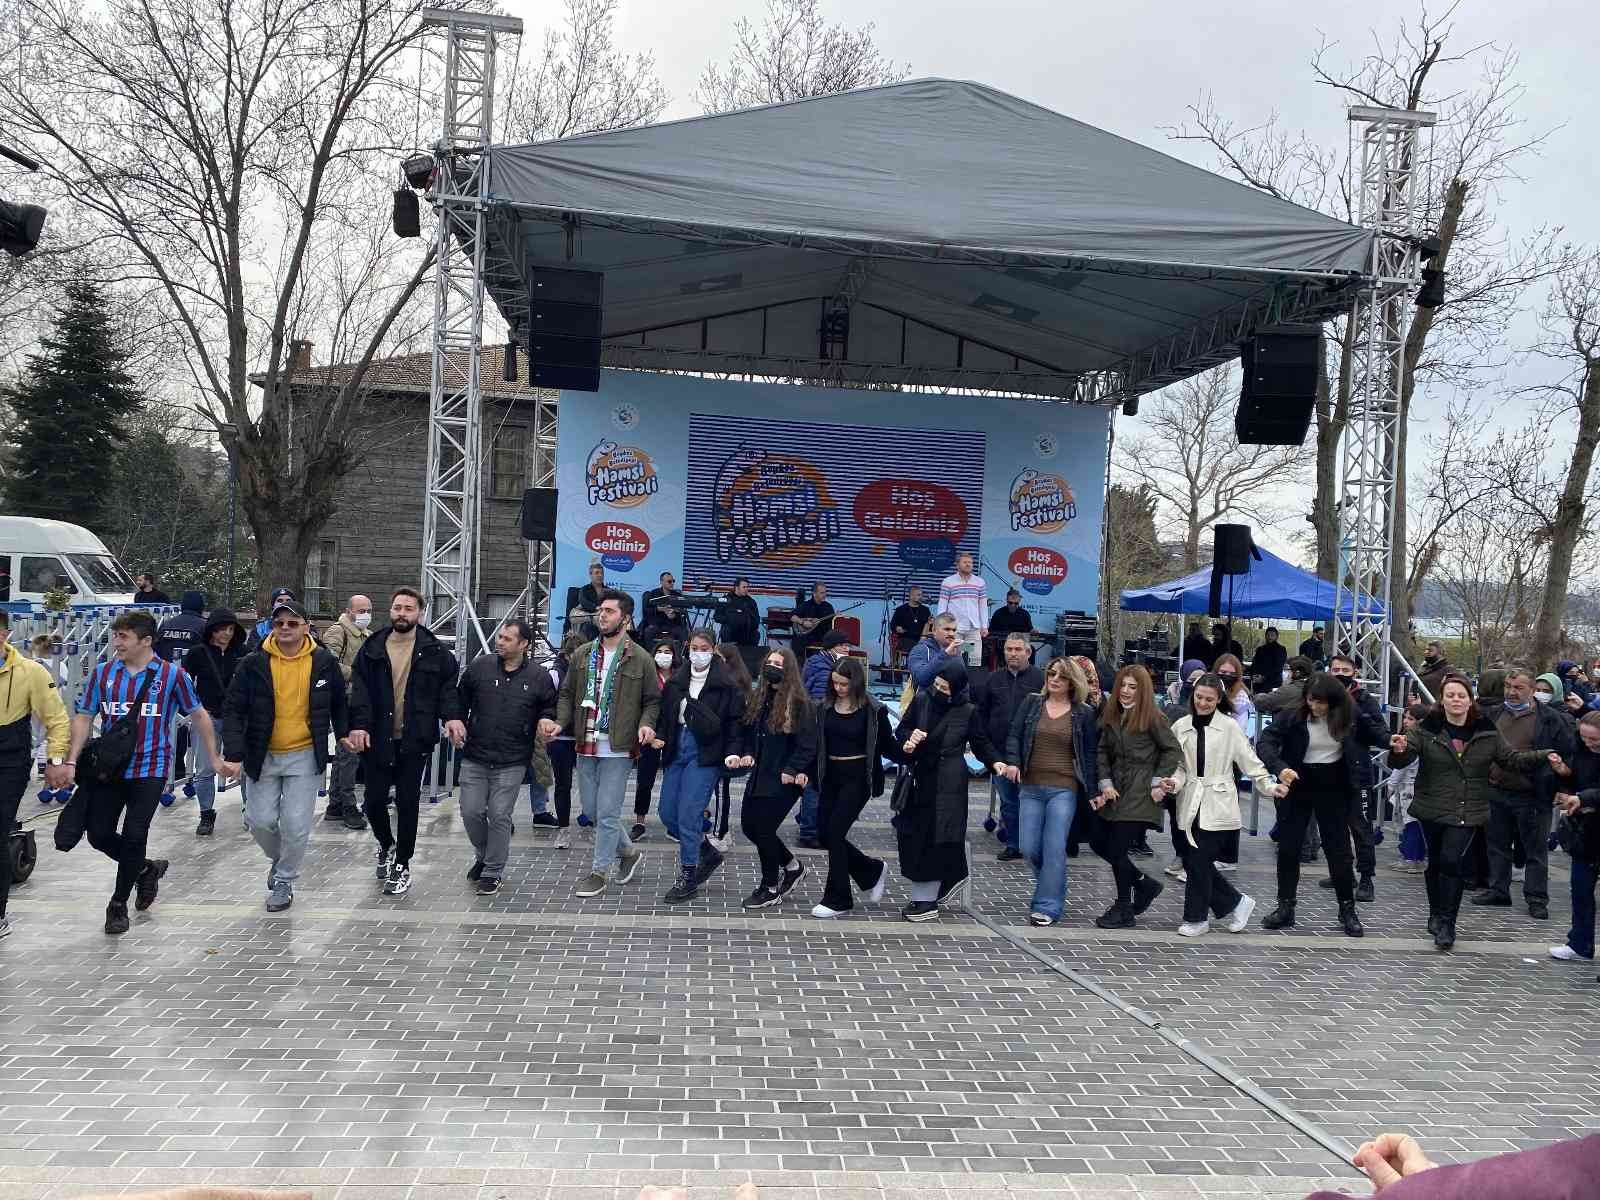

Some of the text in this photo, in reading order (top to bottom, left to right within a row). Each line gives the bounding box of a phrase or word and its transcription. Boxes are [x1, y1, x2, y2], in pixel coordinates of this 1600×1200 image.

[596, 462, 645, 487] Hamsi
[588, 477, 658, 505] Festivali
[891, 486, 935, 510] Hoş
[1019, 490, 1063, 513] Hamsi
[732, 483, 816, 527] Hamsi
[864, 510, 960, 532] Geldiniz
[1012, 503, 1076, 531] Festivali
[607, 526, 632, 539] Hoş
[719, 513, 839, 562] Festivali
[591, 539, 646, 552] Geldiniz
[1028, 551, 1051, 563] Hoş
[1014, 563, 1064, 576] Geldiniz
[163, 630, 191, 641] ZABITA
[101, 702, 162, 716] VESEL
